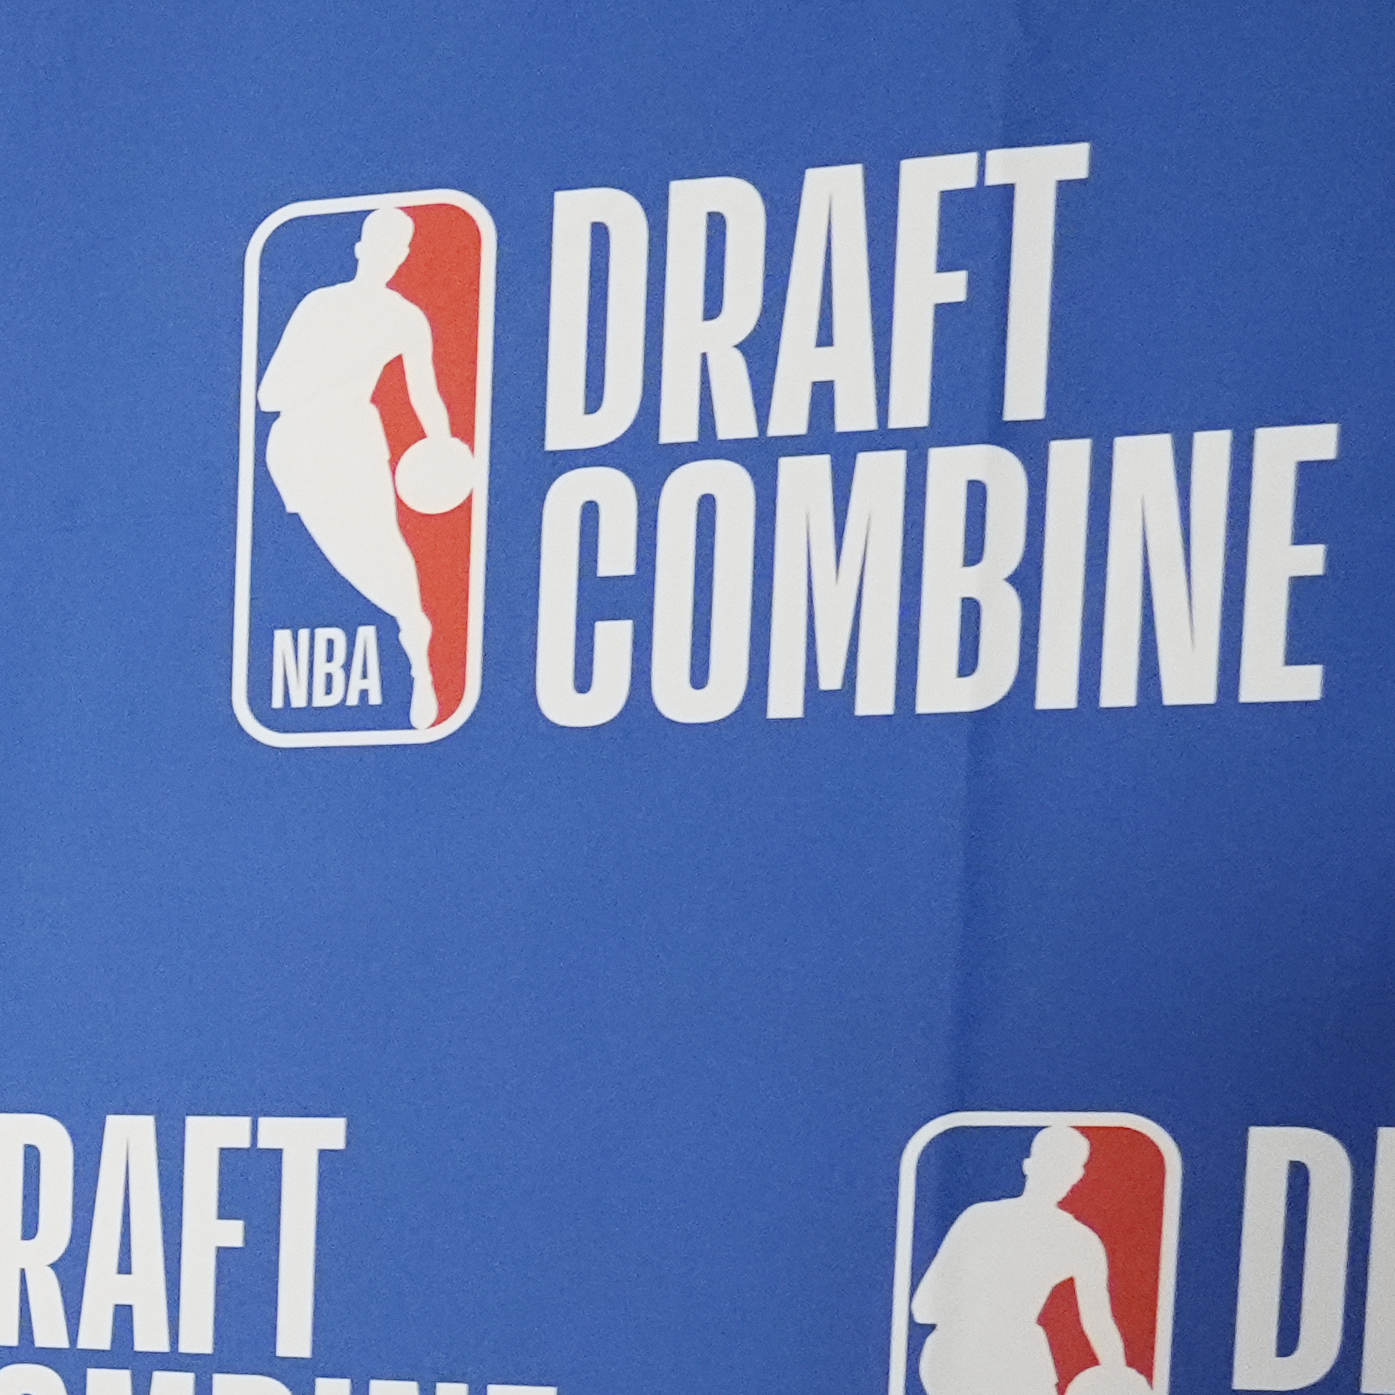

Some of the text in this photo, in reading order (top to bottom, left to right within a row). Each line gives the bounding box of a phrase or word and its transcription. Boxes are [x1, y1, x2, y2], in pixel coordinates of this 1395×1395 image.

[545, 143, 1091, 451] DRAFT
[271, 626, 383, 709] NBA
[536, 423, 1340, 727] COMBINE
